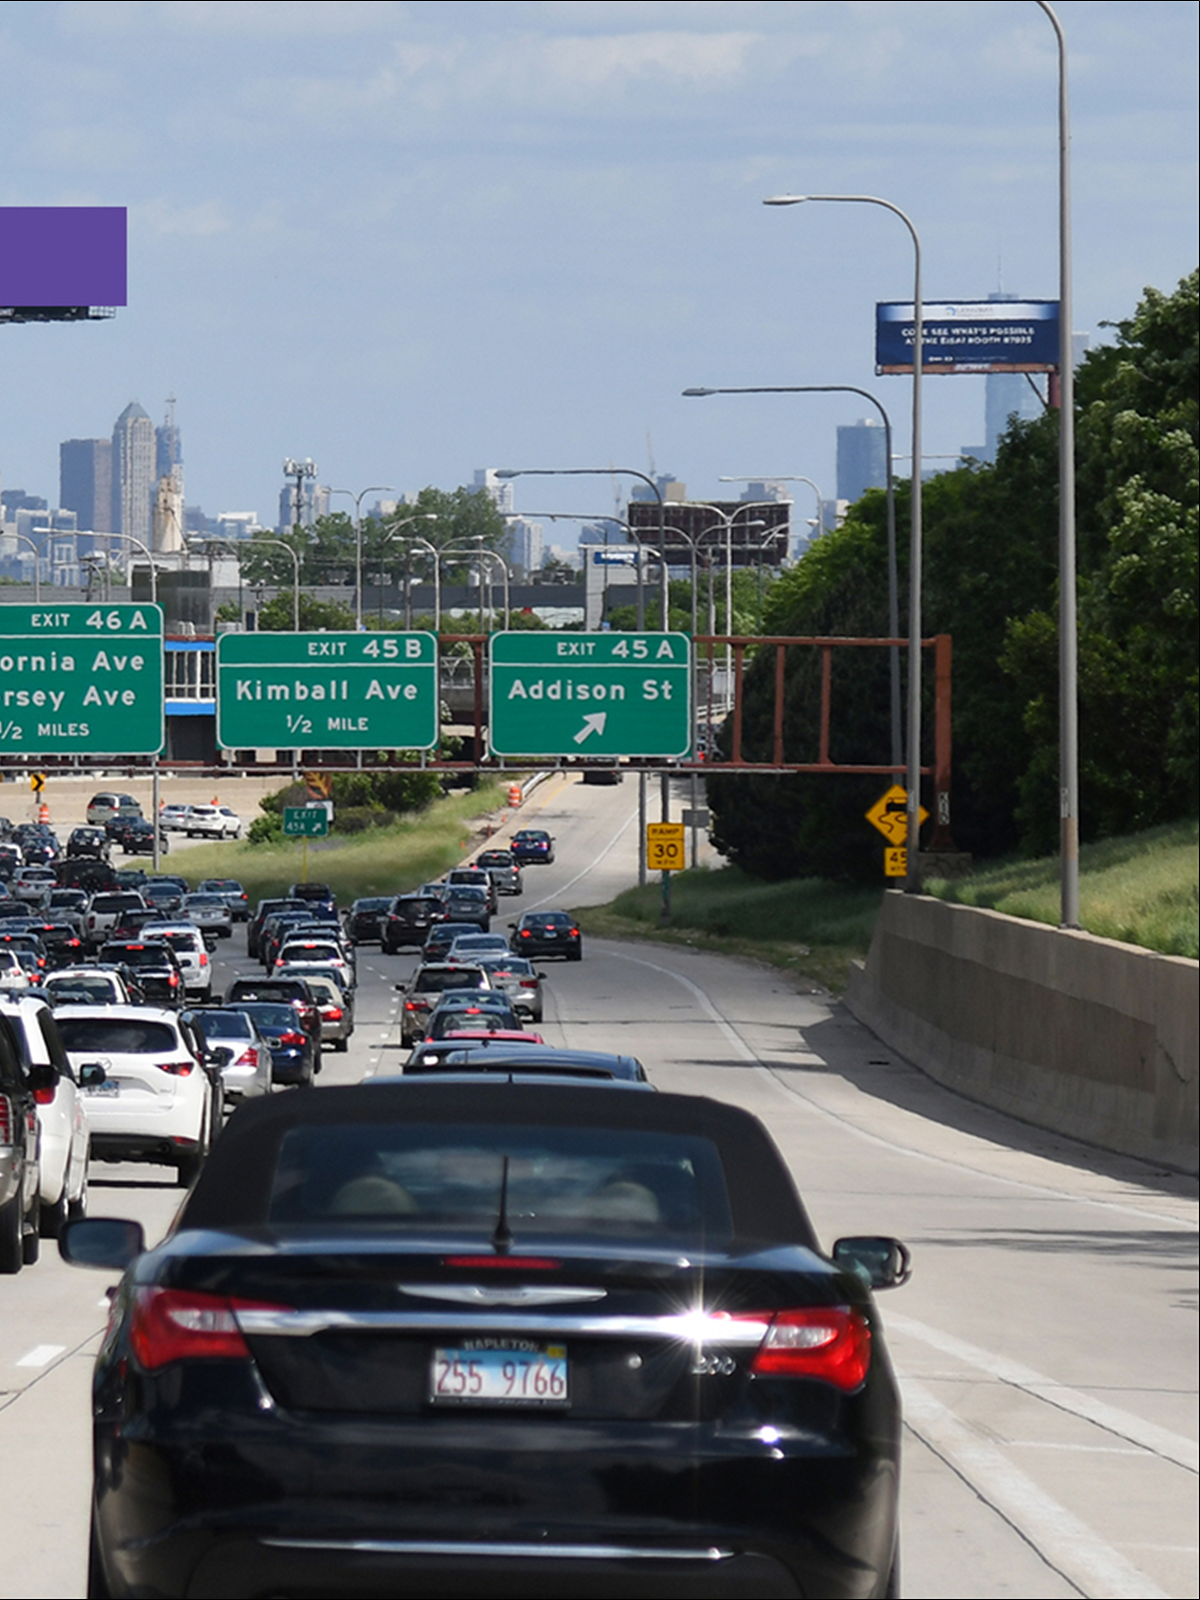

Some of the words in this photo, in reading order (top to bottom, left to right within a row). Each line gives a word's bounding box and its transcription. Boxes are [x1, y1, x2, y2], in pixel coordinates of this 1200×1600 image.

[901, 328, 929, 336] COE
[31, 613, 70, 627] EXIT
[307, 642, 347, 656] EXIT
[557, 642, 596, 656] EXIT
[91, 650, 144, 672] Ave
[82, 685, 136, 706] Ave
[236, 680, 348, 701] Kimball
[364, 679, 418, 700] Ave
[508, 679, 625, 701] Addison
[642, 679, 673, 700] St
[37, 723, 90, 737] MILES
[327, 717, 369, 731] MILE
[653, 843, 679, 858] 30
[464, 1339, 539, 1351] NAPLETON
[437, 1360, 483, 1394] 255
[502, 1360, 565, 1396] 9766
